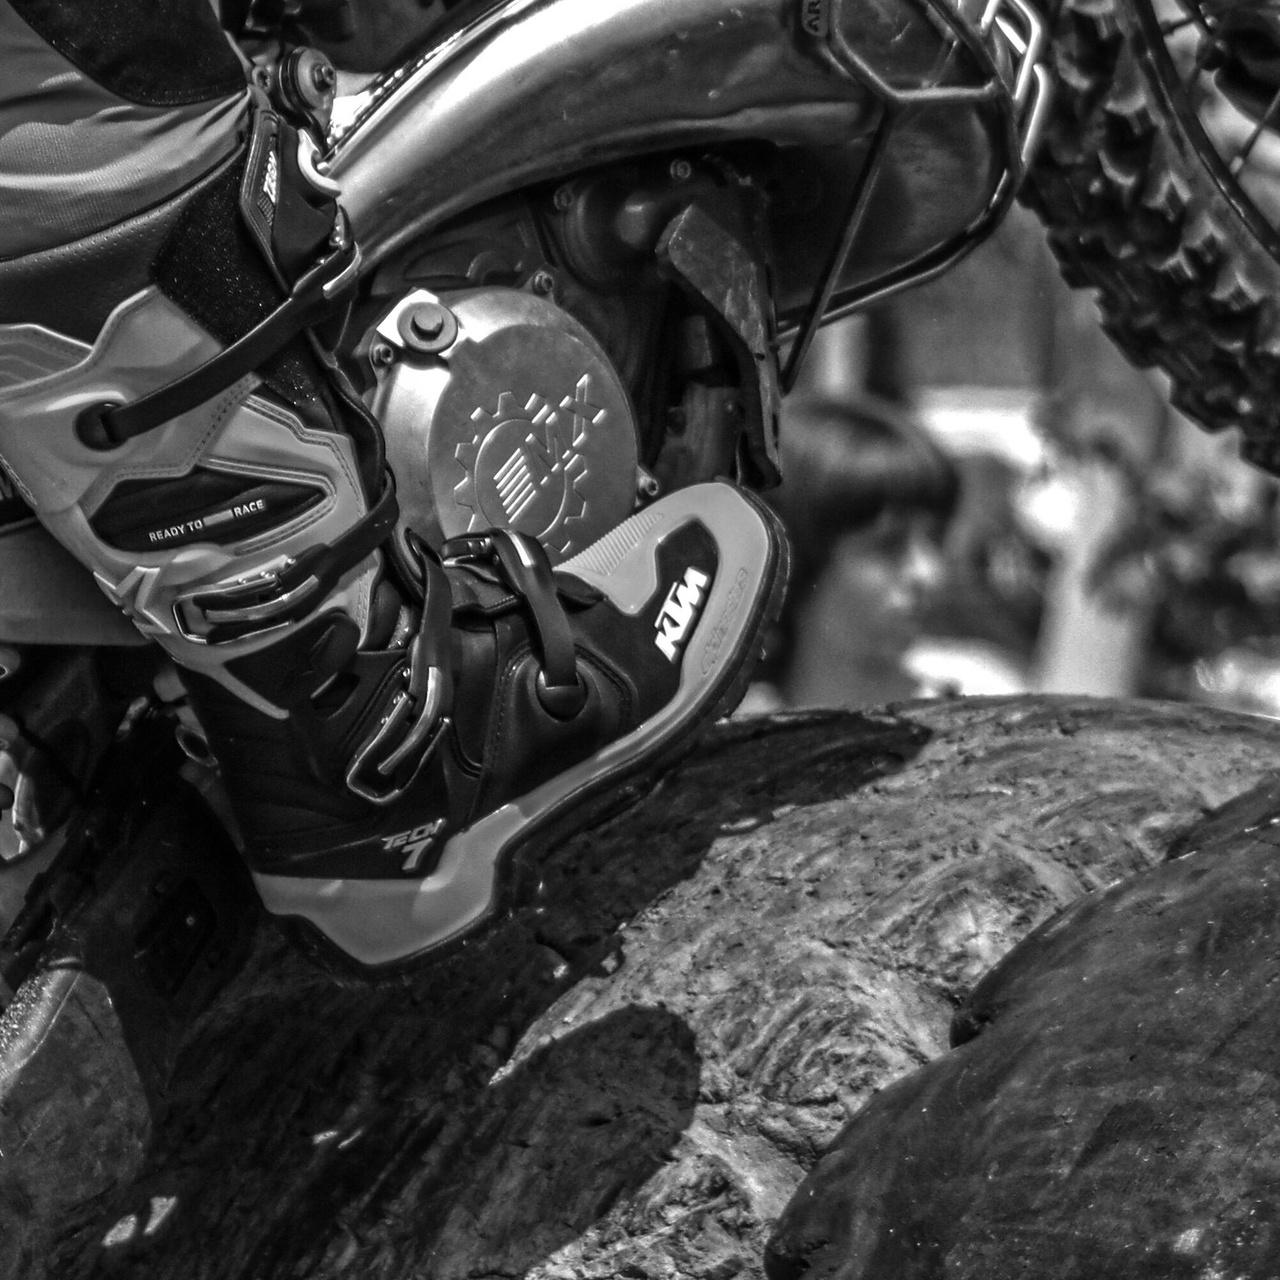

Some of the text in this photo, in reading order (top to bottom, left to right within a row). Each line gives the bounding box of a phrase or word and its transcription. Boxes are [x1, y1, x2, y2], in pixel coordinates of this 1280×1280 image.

[148, 499, 265, 542] READY TO RACE
[654, 566, 708, 663] KTM
[381, 818, 446, 850] TECH
[401, 837, 432, 871] 7
